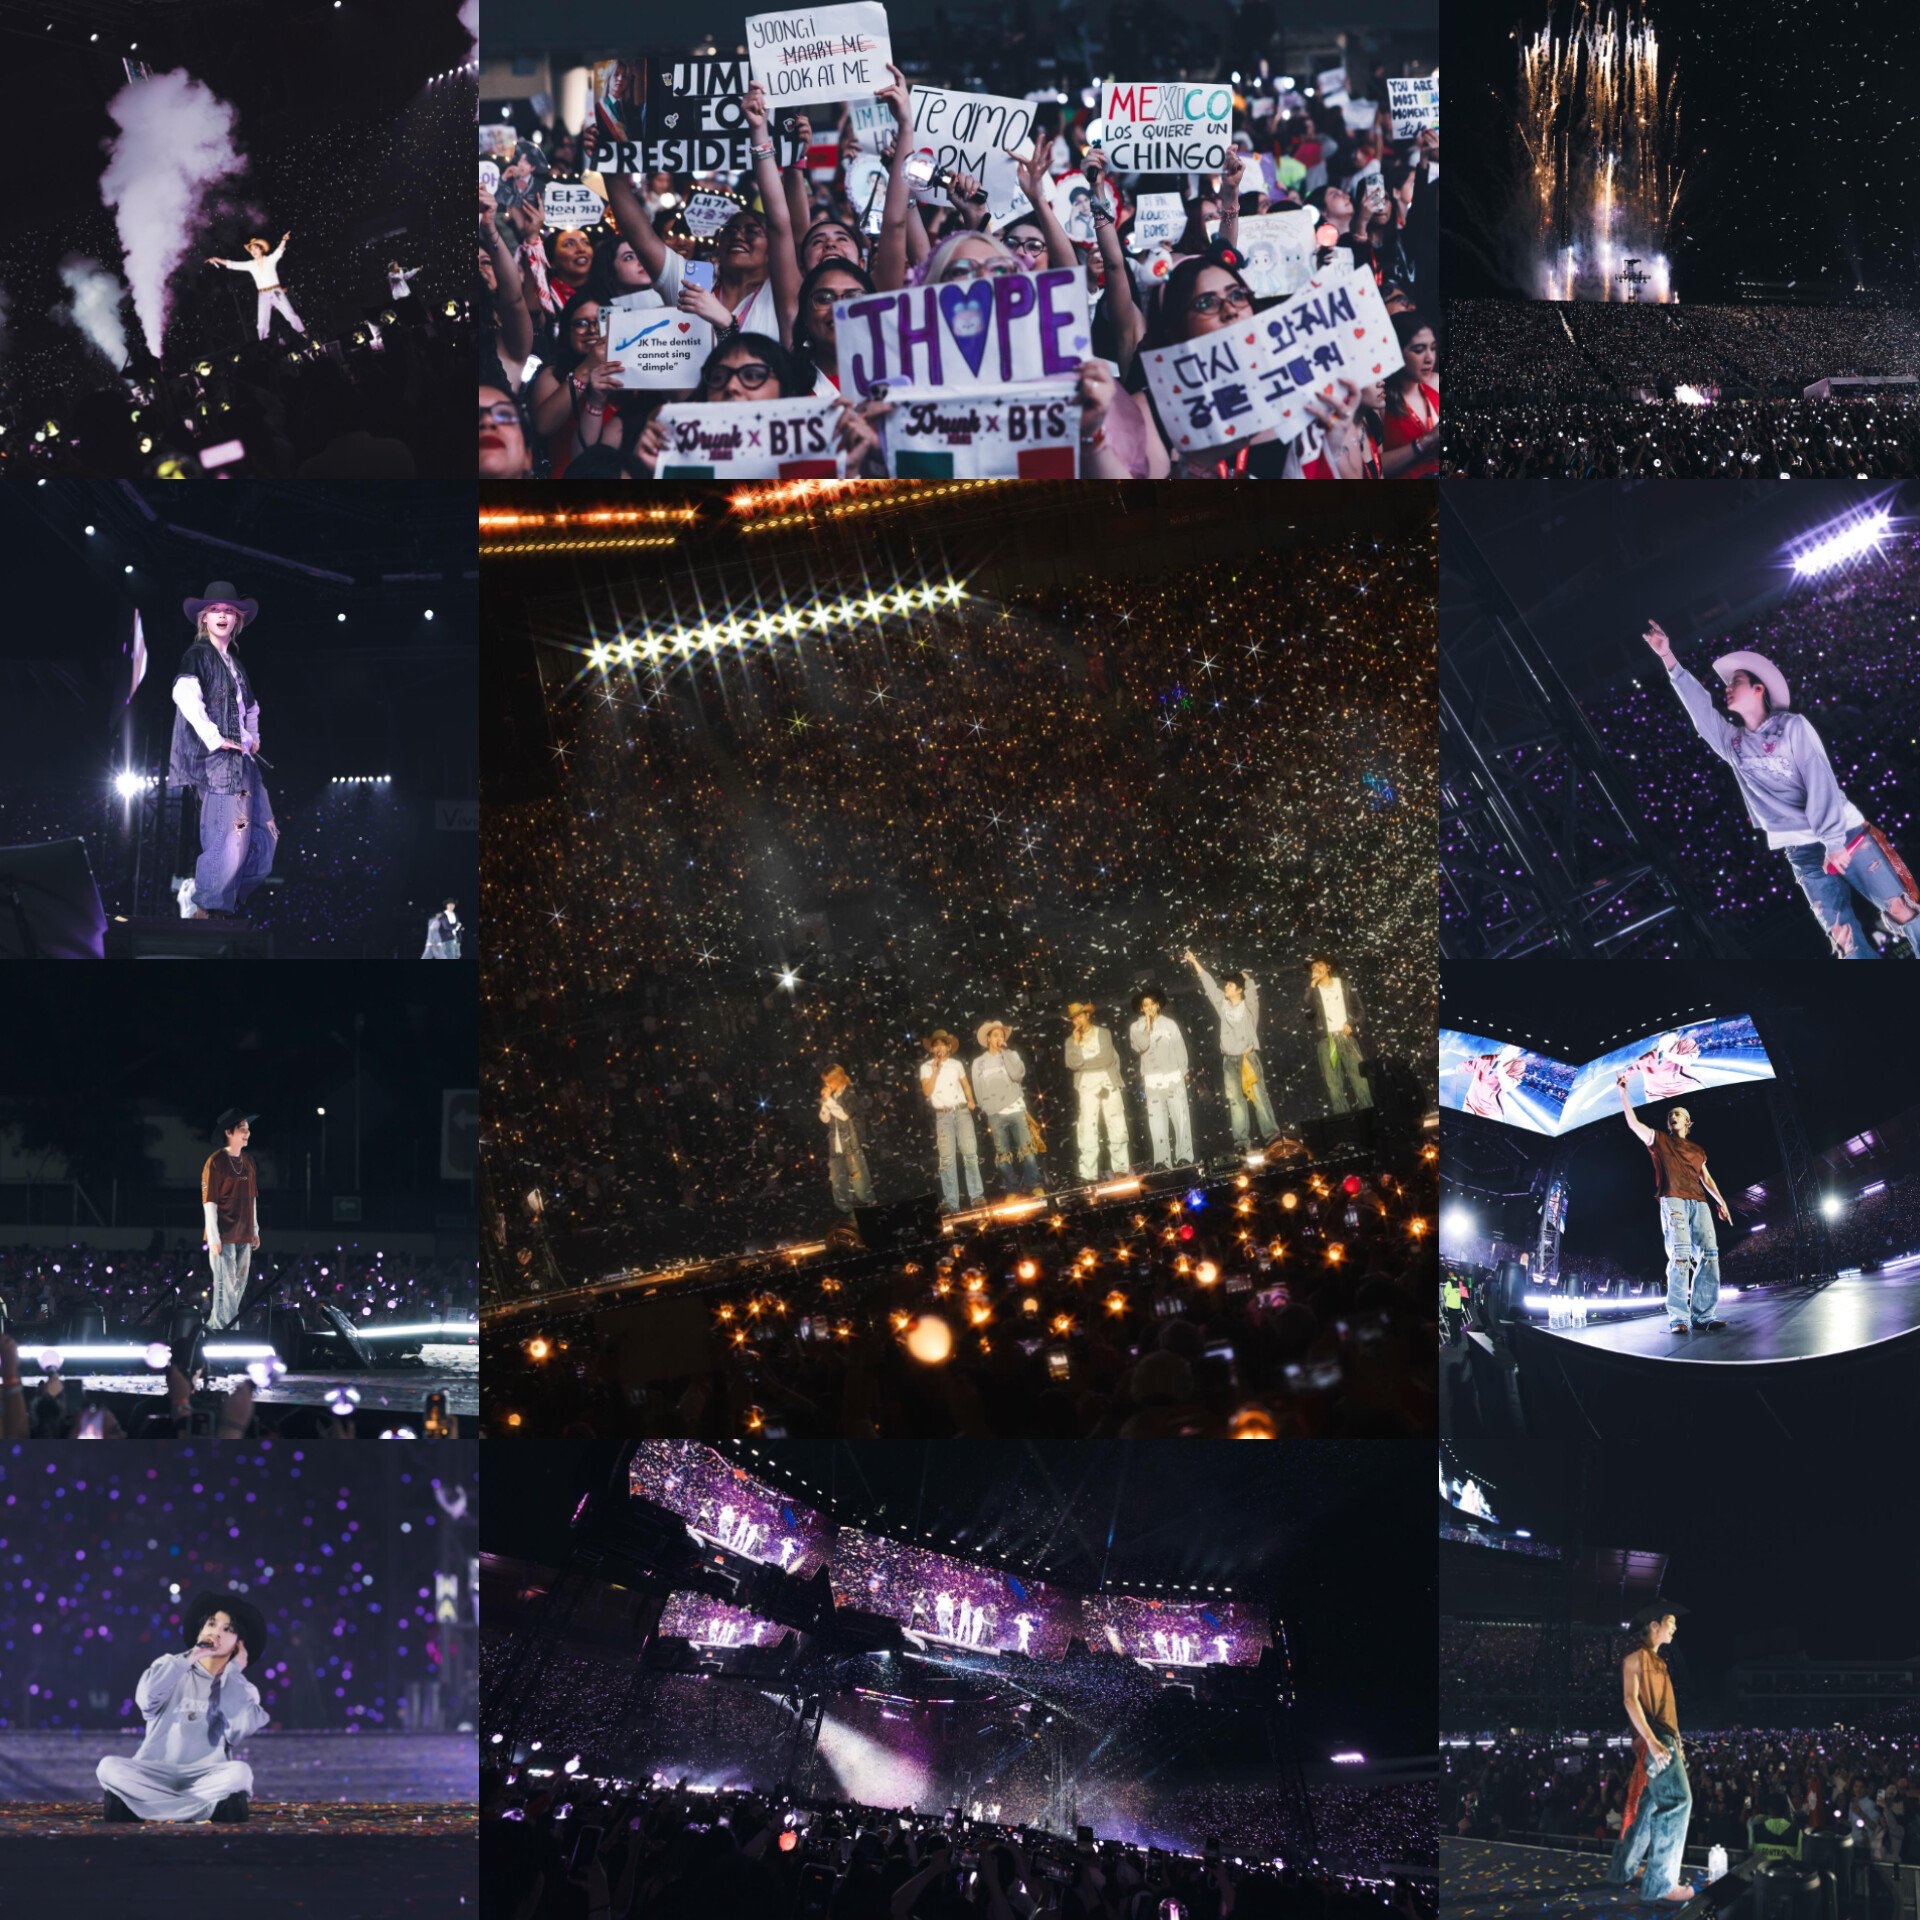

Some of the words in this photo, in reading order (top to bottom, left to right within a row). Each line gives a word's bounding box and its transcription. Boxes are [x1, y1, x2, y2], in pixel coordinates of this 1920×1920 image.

[782, 40, 834, 66] MARRY
[841, 33, 868, 55] ME
[673, 62, 756, 97] JIM
[766, 67, 813, 96] LOOK
[818, 63, 835, 88] AT
[842, 59, 871, 84] ME
[1389, 80, 1408, 92] YOU
[1413, 80, 1433, 91] ARE
[1108, 85, 1232, 122] MEXICO
[1392, 94, 1418, 107] MOST
[1392, 107, 1430, 120] MOMENT
[913, 88, 947, 134] Te
[952, 101, 1029, 152] amo
[1105, 124, 1132, 142] LOS
[1142, 123, 1194, 139] QUIERE
[1207, 122, 1228, 134] UN
[1111, 142, 1226, 170] CHINGO
[552, 189, 591, 203] 타코
[694, 196, 729, 209] 내가
[544, 204, 576, 217] 먹으러
[580, 204, 602, 215] 가자
[637, 351, 669, 359] cannot
[671, 349, 691, 360] sing
[638, 339, 649, 347] JK
[651, 338, 667, 347] The
[669, 337, 702, 346] dentist
[1172, 341, 1239, 389] 다시
[1182, 382, 1253, 430] 정말
[1258, 340, 1345, 402] 고마워
[675, 420, 743, 454] Drunk
[769, 416, 828, 456] BTS
[905, 403, 981, 436] Drunk
[1007, 403, 1067, 442] BTS
